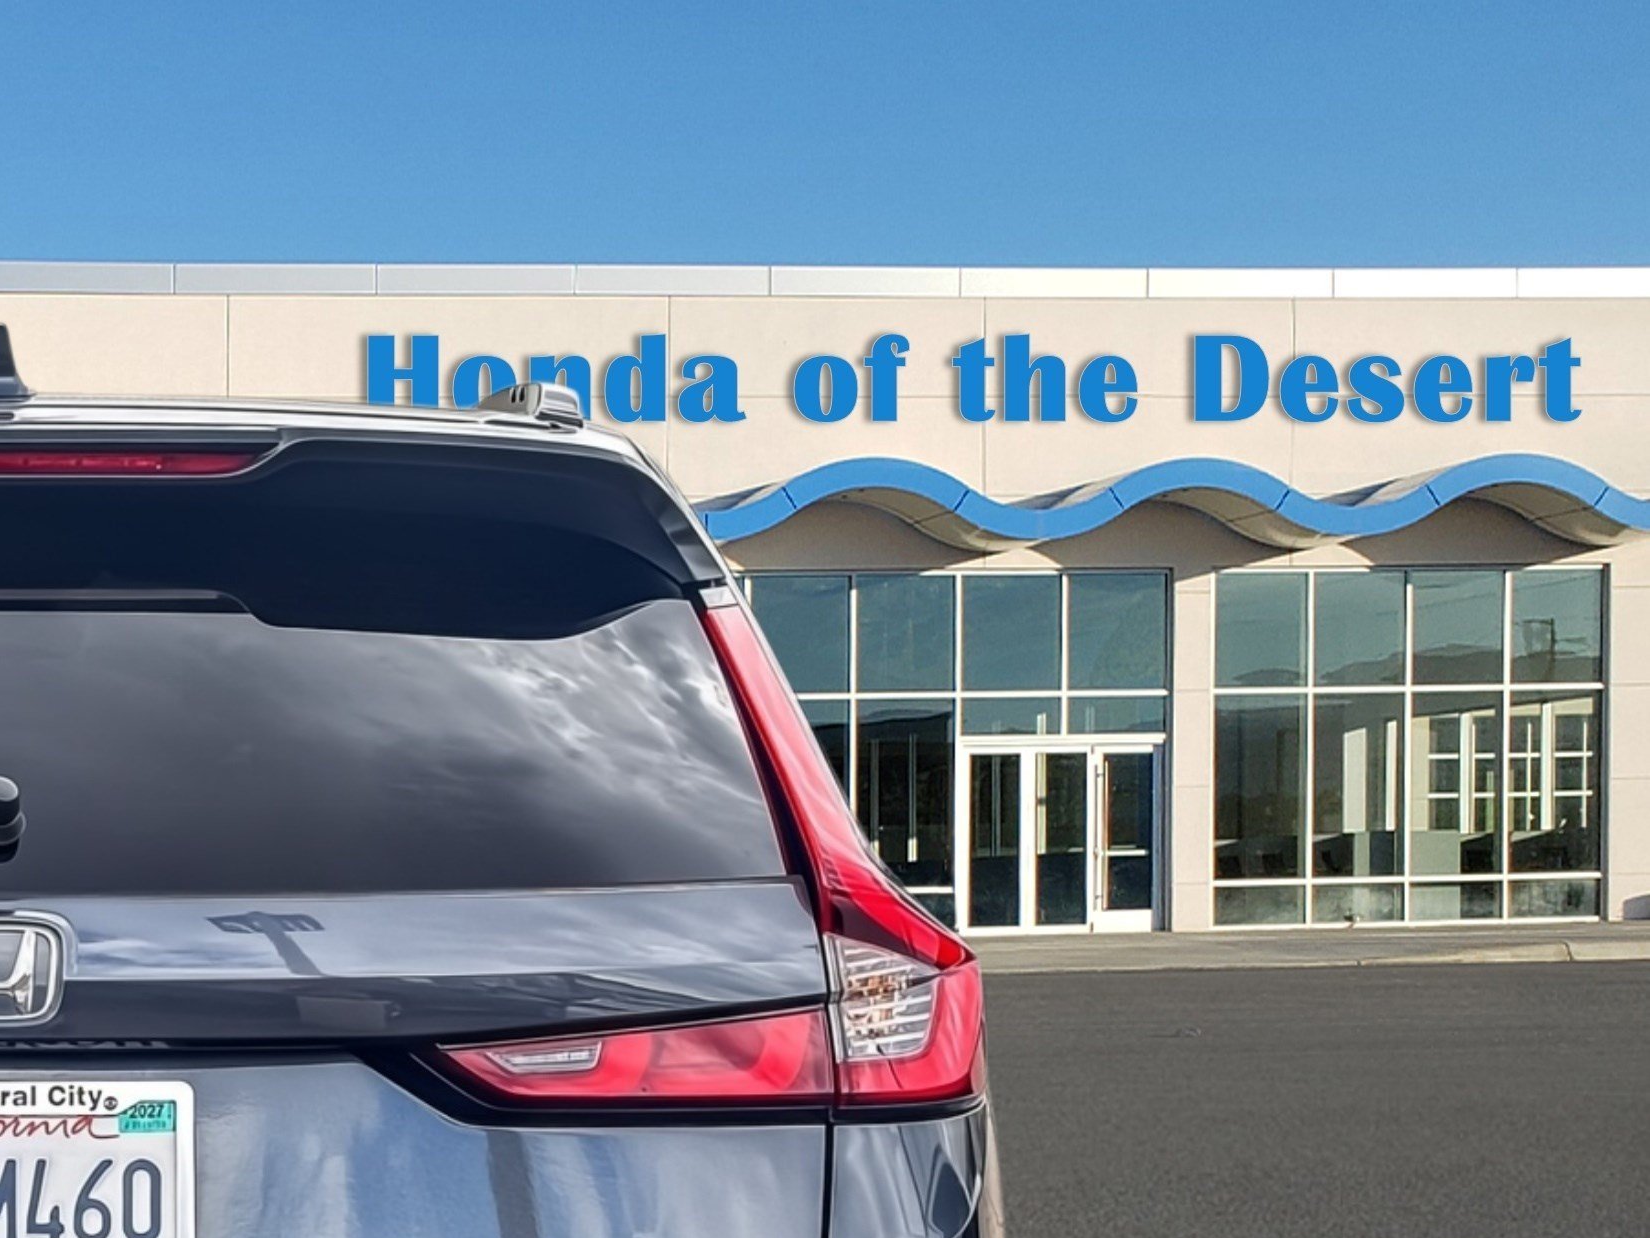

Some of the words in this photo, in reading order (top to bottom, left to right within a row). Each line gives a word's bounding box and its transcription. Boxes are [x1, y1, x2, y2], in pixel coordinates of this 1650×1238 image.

[366, 333, 747, 423] Honda
[791, 333, 909, 423] of
[951, 333, 1138, 423] the
[1193, 333, 1581, 423] Desert
[47, 1084, 103, 1111] City
[128, 1103, 165, 1119] 2027
